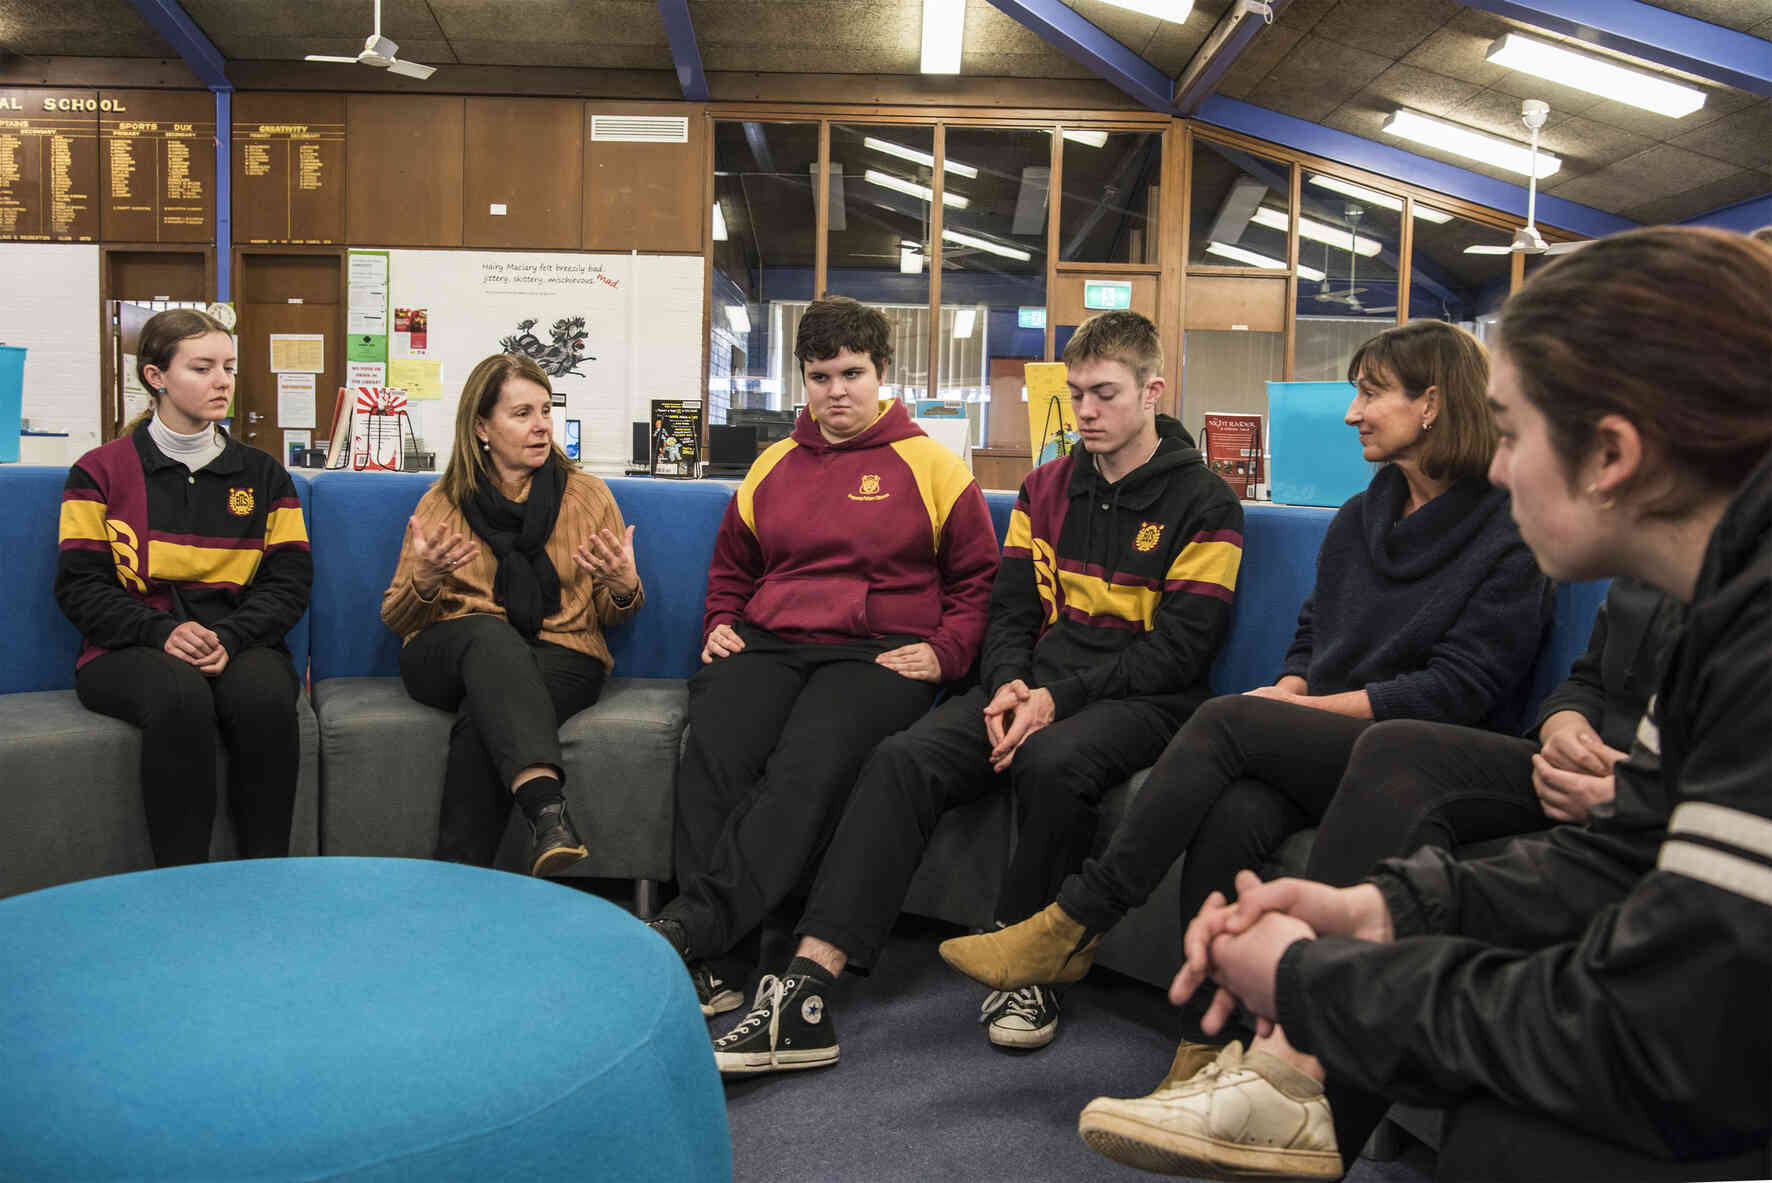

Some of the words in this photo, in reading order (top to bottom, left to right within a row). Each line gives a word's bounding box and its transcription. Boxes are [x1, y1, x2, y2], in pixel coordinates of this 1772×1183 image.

[43, 97, 126, 112] SCHOOL
[119, 122, 158, 131] SPORTS
[258, 125, 309, 134] CREATIVITY
[482, 263, 504, 273] Hairy
[539, 264, 553, 272] felt
[556, 264, 586, 274] breezily
[596, 273, 620, 288] mad
